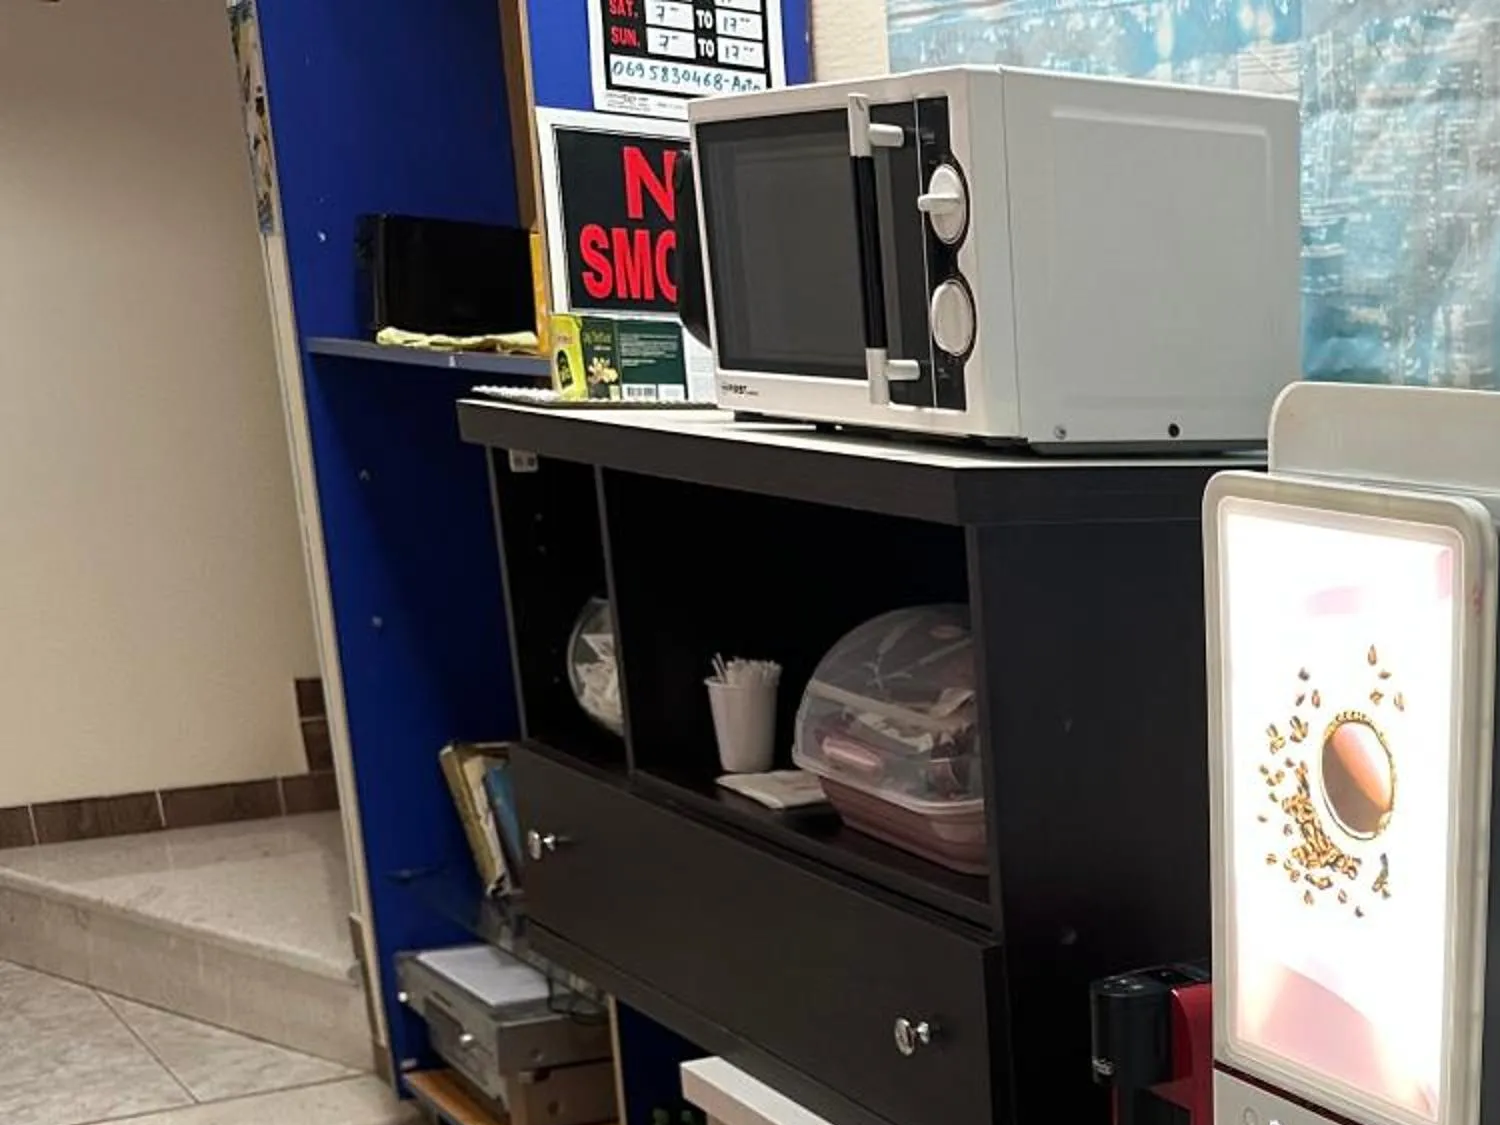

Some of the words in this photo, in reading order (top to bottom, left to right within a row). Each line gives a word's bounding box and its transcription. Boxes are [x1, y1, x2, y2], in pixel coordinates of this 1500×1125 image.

[696, 10, 714, 29] TO
[610, 26, 640, 47] SUN.
[698, 39, 715, 58] TO
